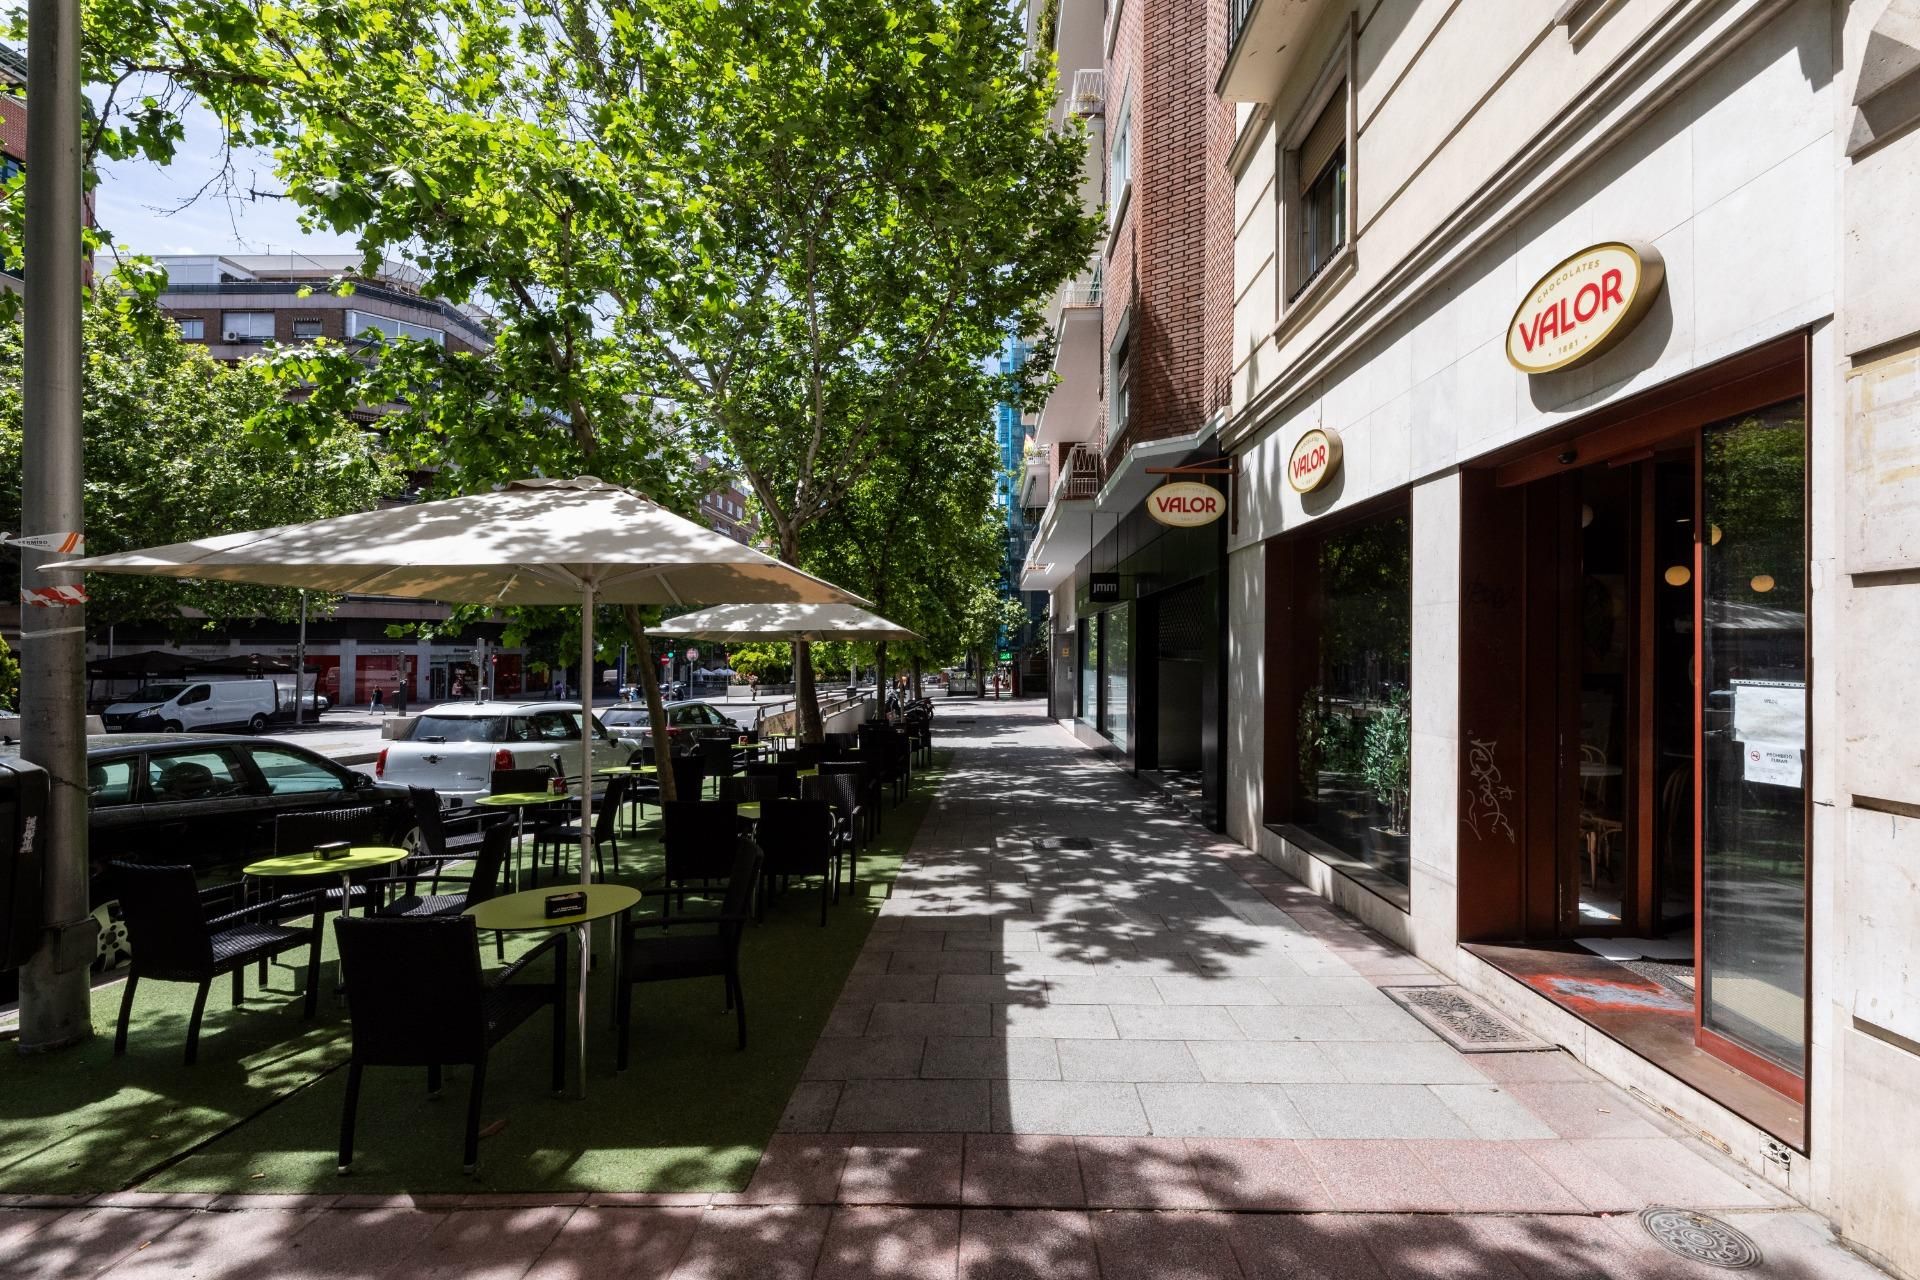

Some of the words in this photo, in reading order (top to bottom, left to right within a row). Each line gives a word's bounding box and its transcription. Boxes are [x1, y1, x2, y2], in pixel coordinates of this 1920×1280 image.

[1536, 259, 1601, 304] CHOCOLATES
[1518, 268, 1624, 353] VALOR
[1557, 339, 1579, 355] 1881
[1292, 444, 1326, 480] VALOR
[1155, 496, 1217, 513] VALOR
